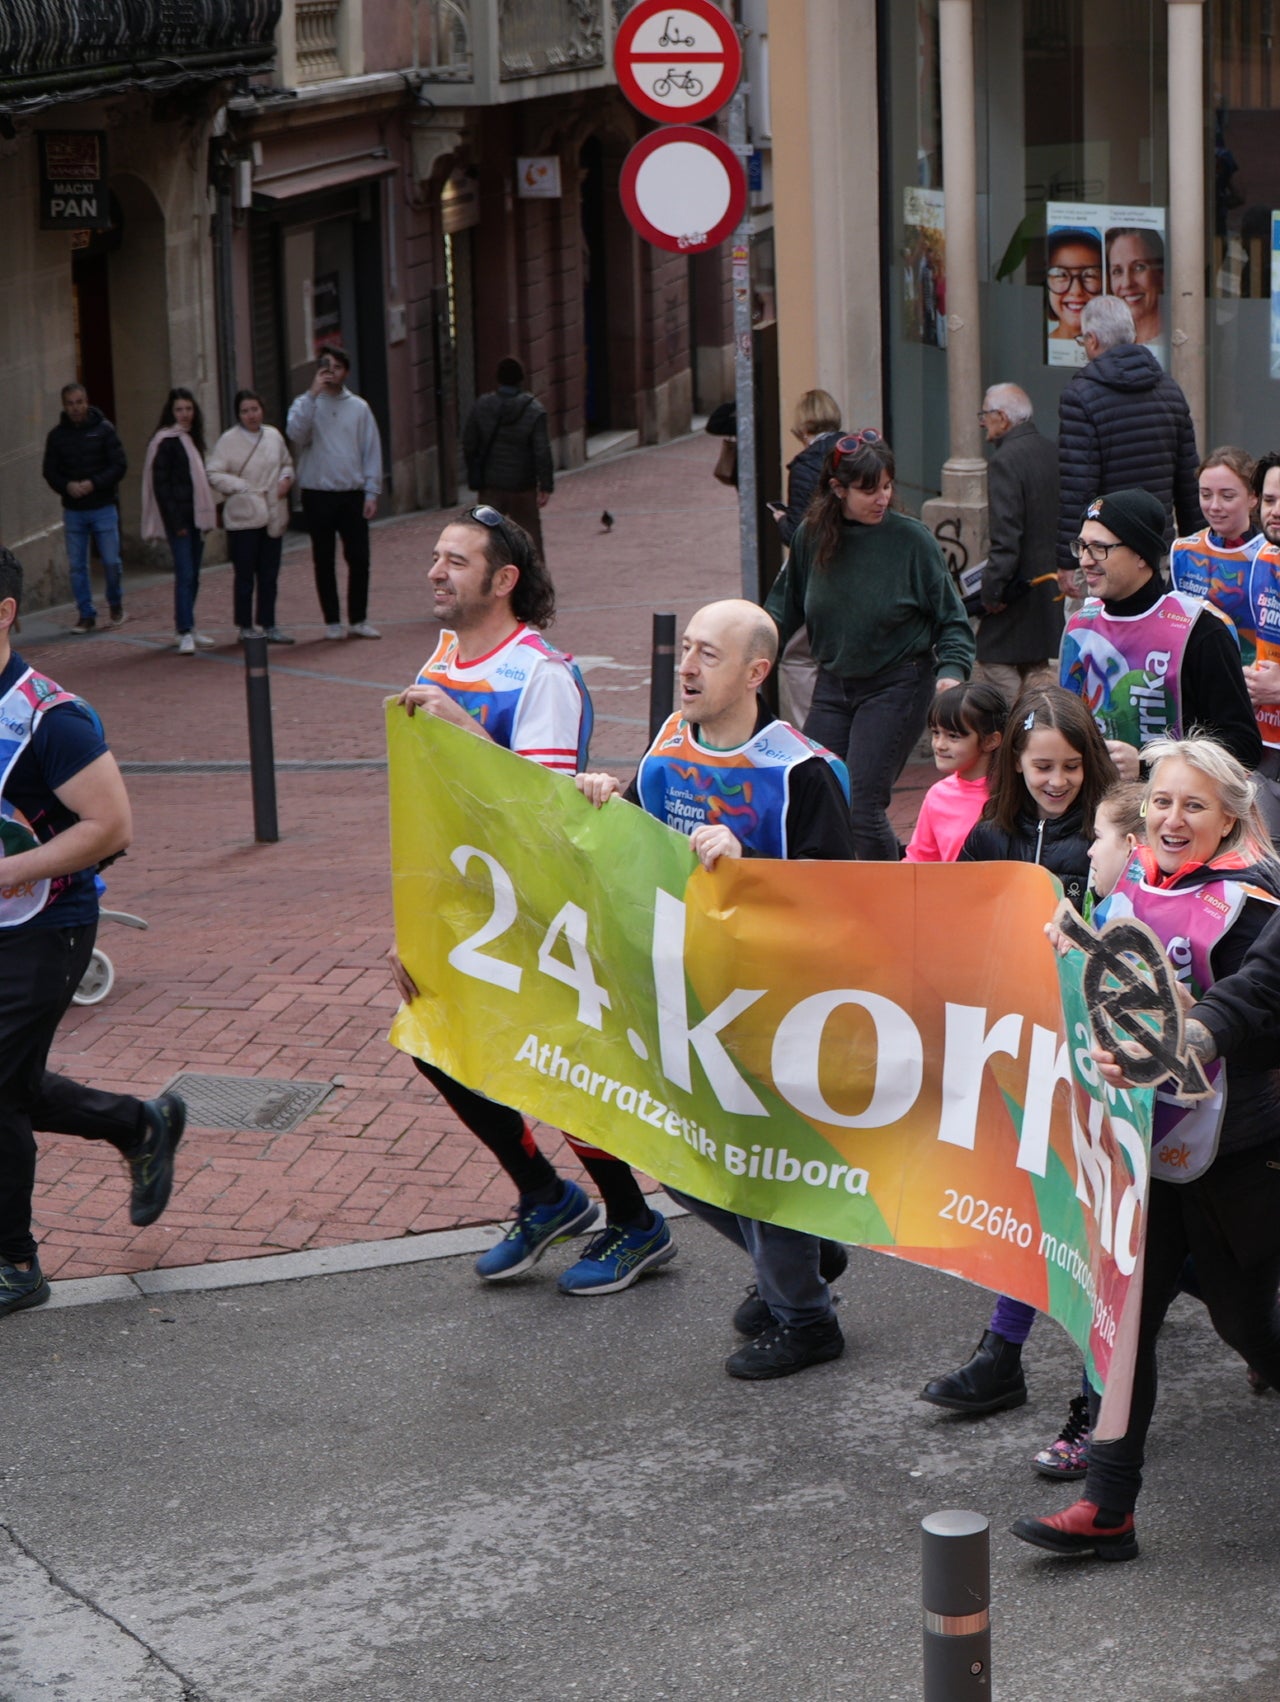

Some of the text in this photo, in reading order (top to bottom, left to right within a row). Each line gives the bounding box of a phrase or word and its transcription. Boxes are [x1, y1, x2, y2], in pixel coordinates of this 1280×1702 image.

[50, 198, 97, 217] PAN
[1167, 613, 1192, 623] EROSKI
[504, 669, 527, 682] eitb
[1128, 650, 1172, 743] rrika
[766, 750, 794, 763] eitb
[1204, 893, 1231, 912] EROSKI
[513, 1033, 870, 1197] Atharratzetik Bilbora
[1158, 1144, 1191, 1169] aek
[938, 1189, 1033, 1248] 2026ko
